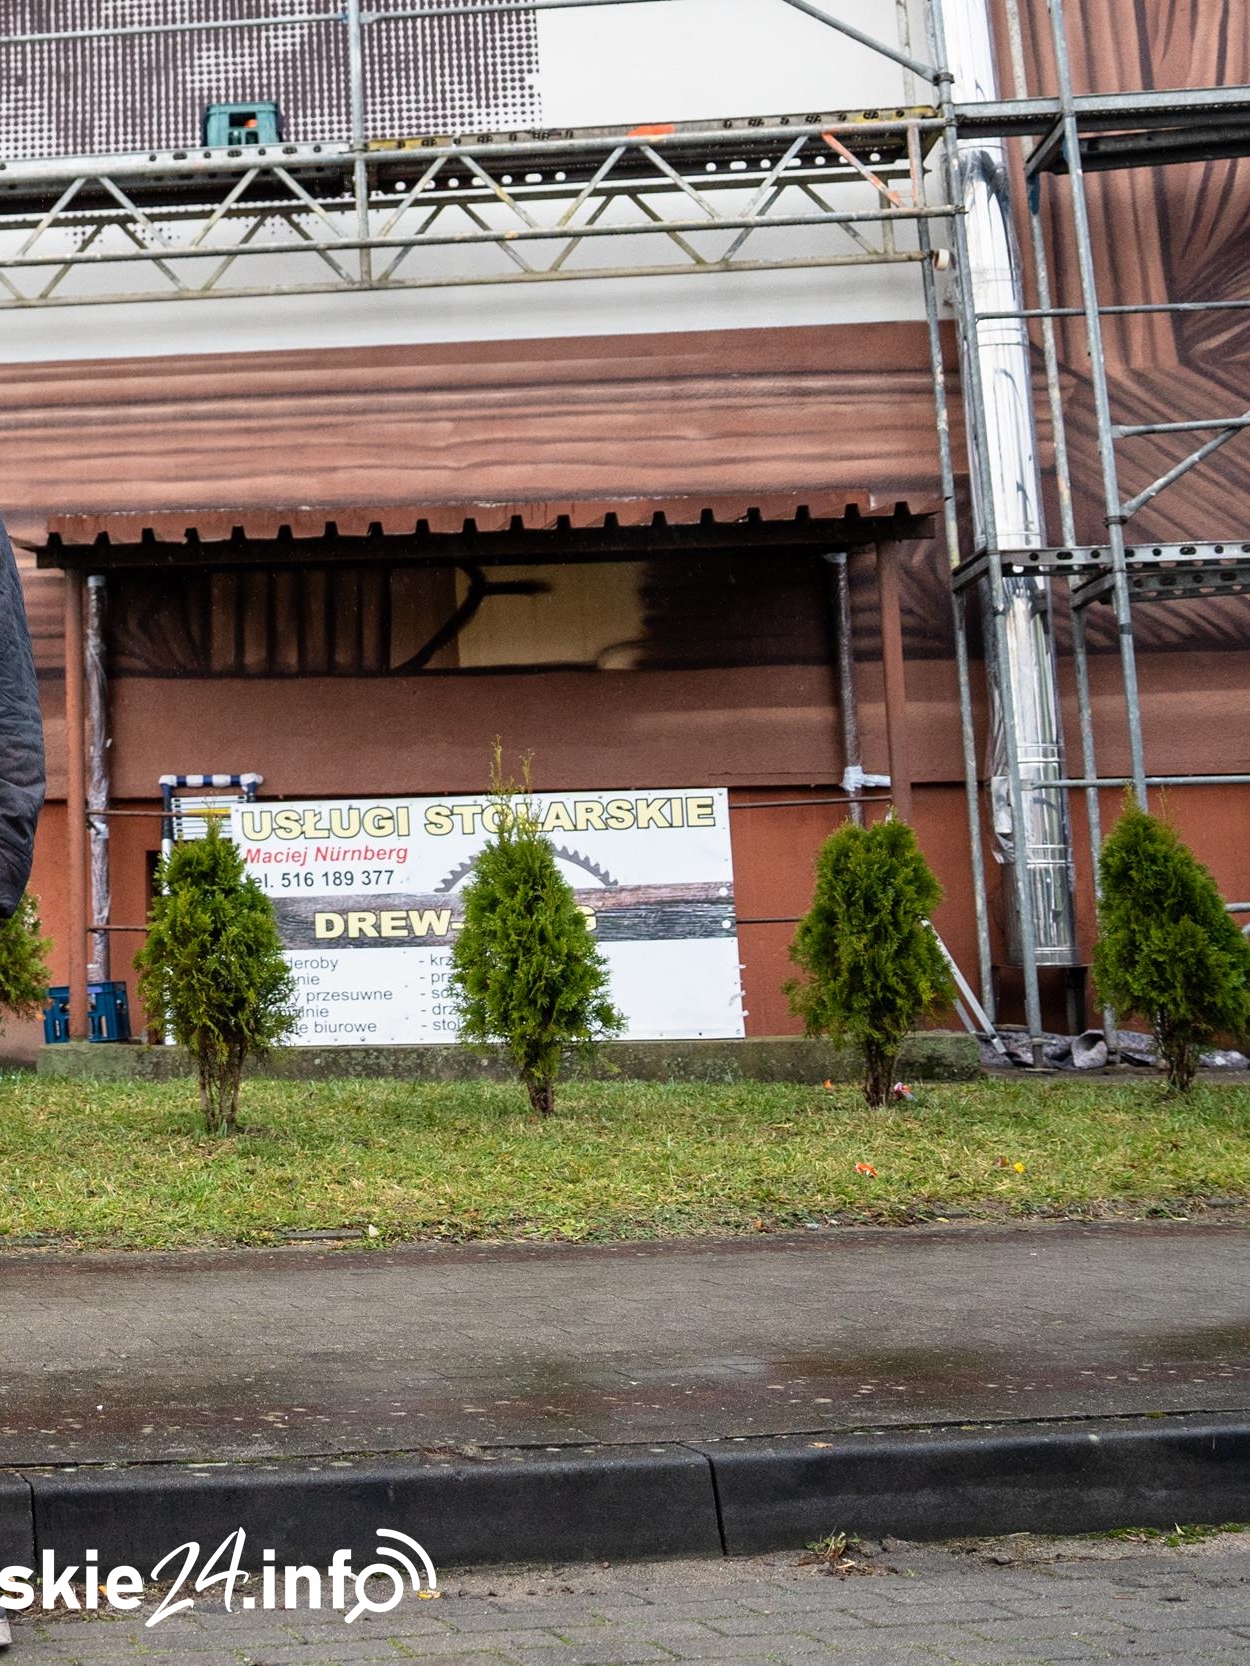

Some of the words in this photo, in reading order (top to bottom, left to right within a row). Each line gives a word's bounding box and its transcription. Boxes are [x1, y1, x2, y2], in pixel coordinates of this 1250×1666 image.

[241, 806, 410, 841] USŁUGI
[244, 847, 308, 867] Maciej
[314, 845, 408, 865] Nürnberg
[251, 872, 274, 889] el.
[281, 871, 315, 888] 516
[322, 870, 354, 887] 189
[362, 869, 394, 886] 377
[306, 990, 393, 1004] przesuwne
[314, 1020, 377, 1034] biurowe
